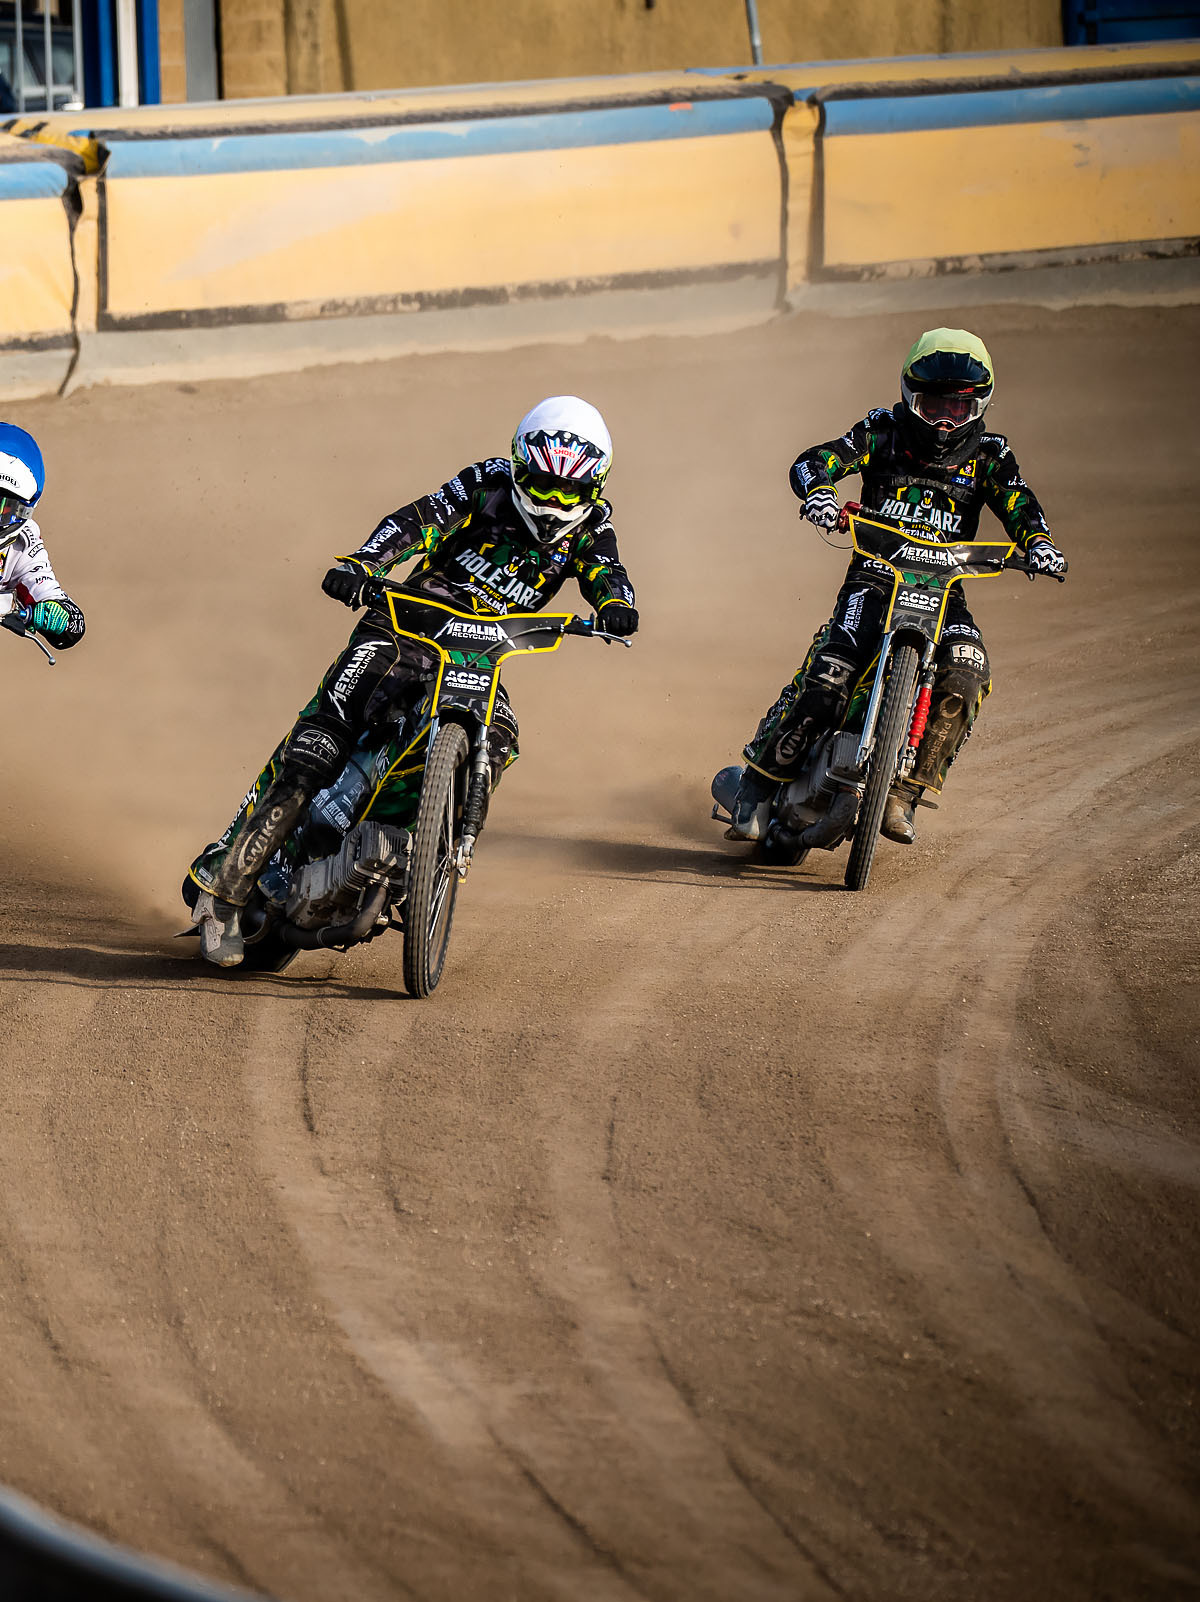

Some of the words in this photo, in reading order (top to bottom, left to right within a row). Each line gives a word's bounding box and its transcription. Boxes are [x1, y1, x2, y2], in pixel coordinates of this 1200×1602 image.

[554, 449, 576, 459] SHOEI
[880, 499, 961, 533] KOLEJARZ
[889, 542, 964, 573] METALIKA
[906, 556, 948, 567] RECYCLING
[455, 549, 543, 609] KOLEJARZ
[897, 590, 940, 608] ACDC
[434, 617, 517, 649] METALIKA
[452, 632, 498, 642] RECYCLING
[327, 641, 393, 720] METALIKA
[345, 649, 376, 696] RECYCLING
[444, 670, 491, 687] ACDC
